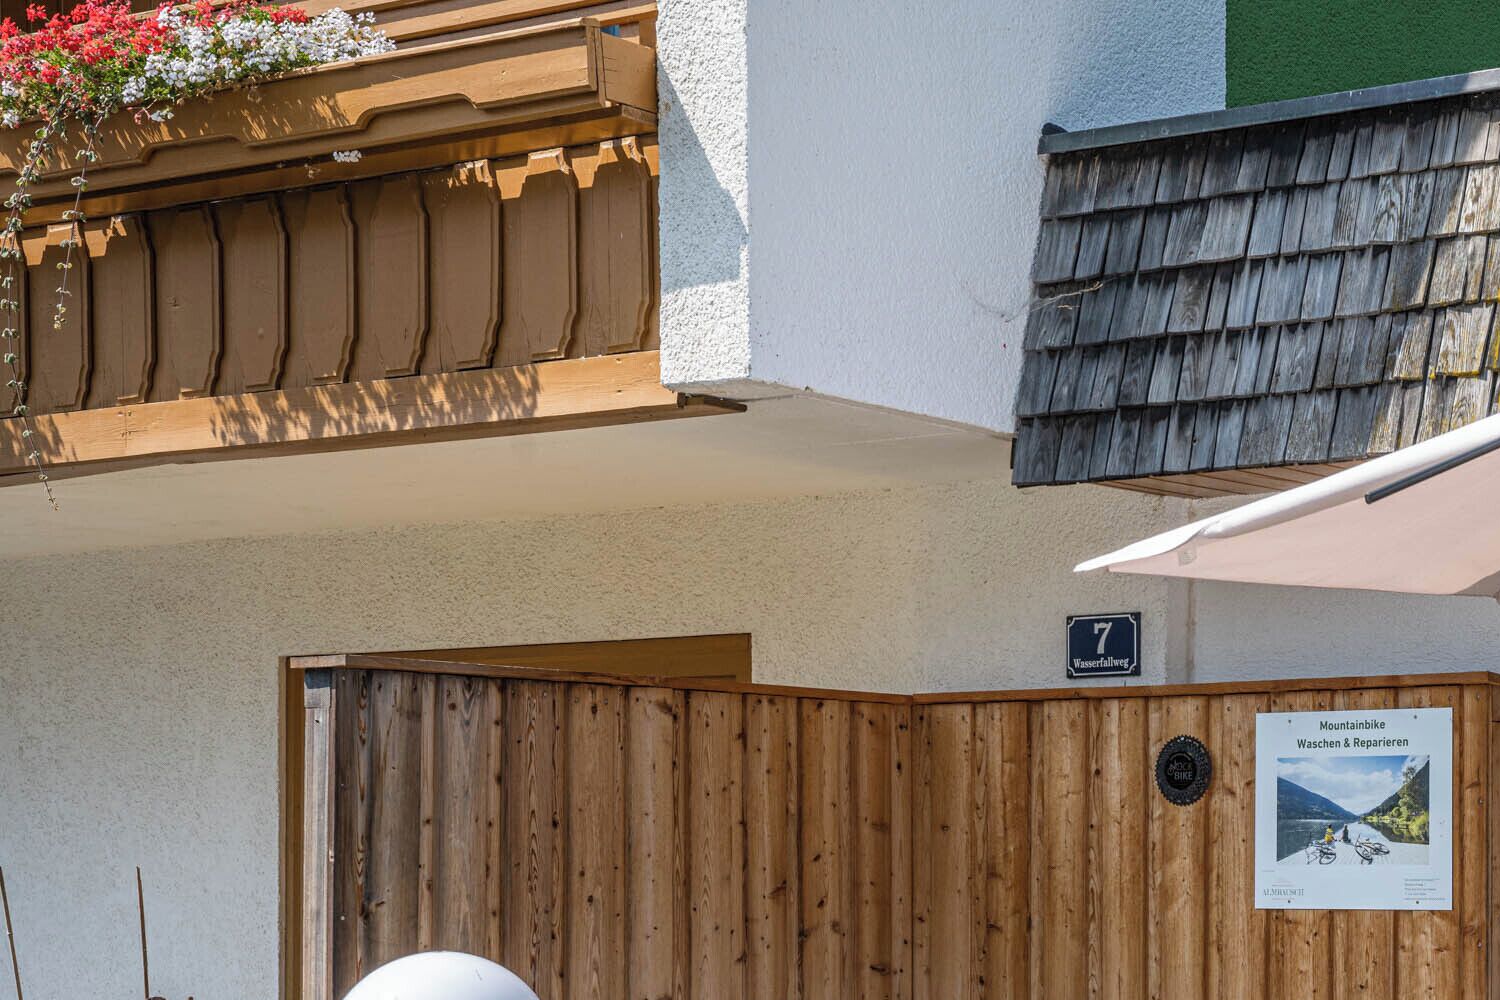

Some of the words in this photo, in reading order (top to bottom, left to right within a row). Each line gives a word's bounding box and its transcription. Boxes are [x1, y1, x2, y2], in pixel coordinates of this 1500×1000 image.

[1093, 621, 1113, 655] 7
[1073, 656, 1130, 669] Wasserfallweg
[1319, 719, 1386, 731] Mountainbike
[1297, 738, 1341, 749] Waschen
[1344, 737, 1351, 748] &
[1353, 736, 1409, 750] Reparieren
